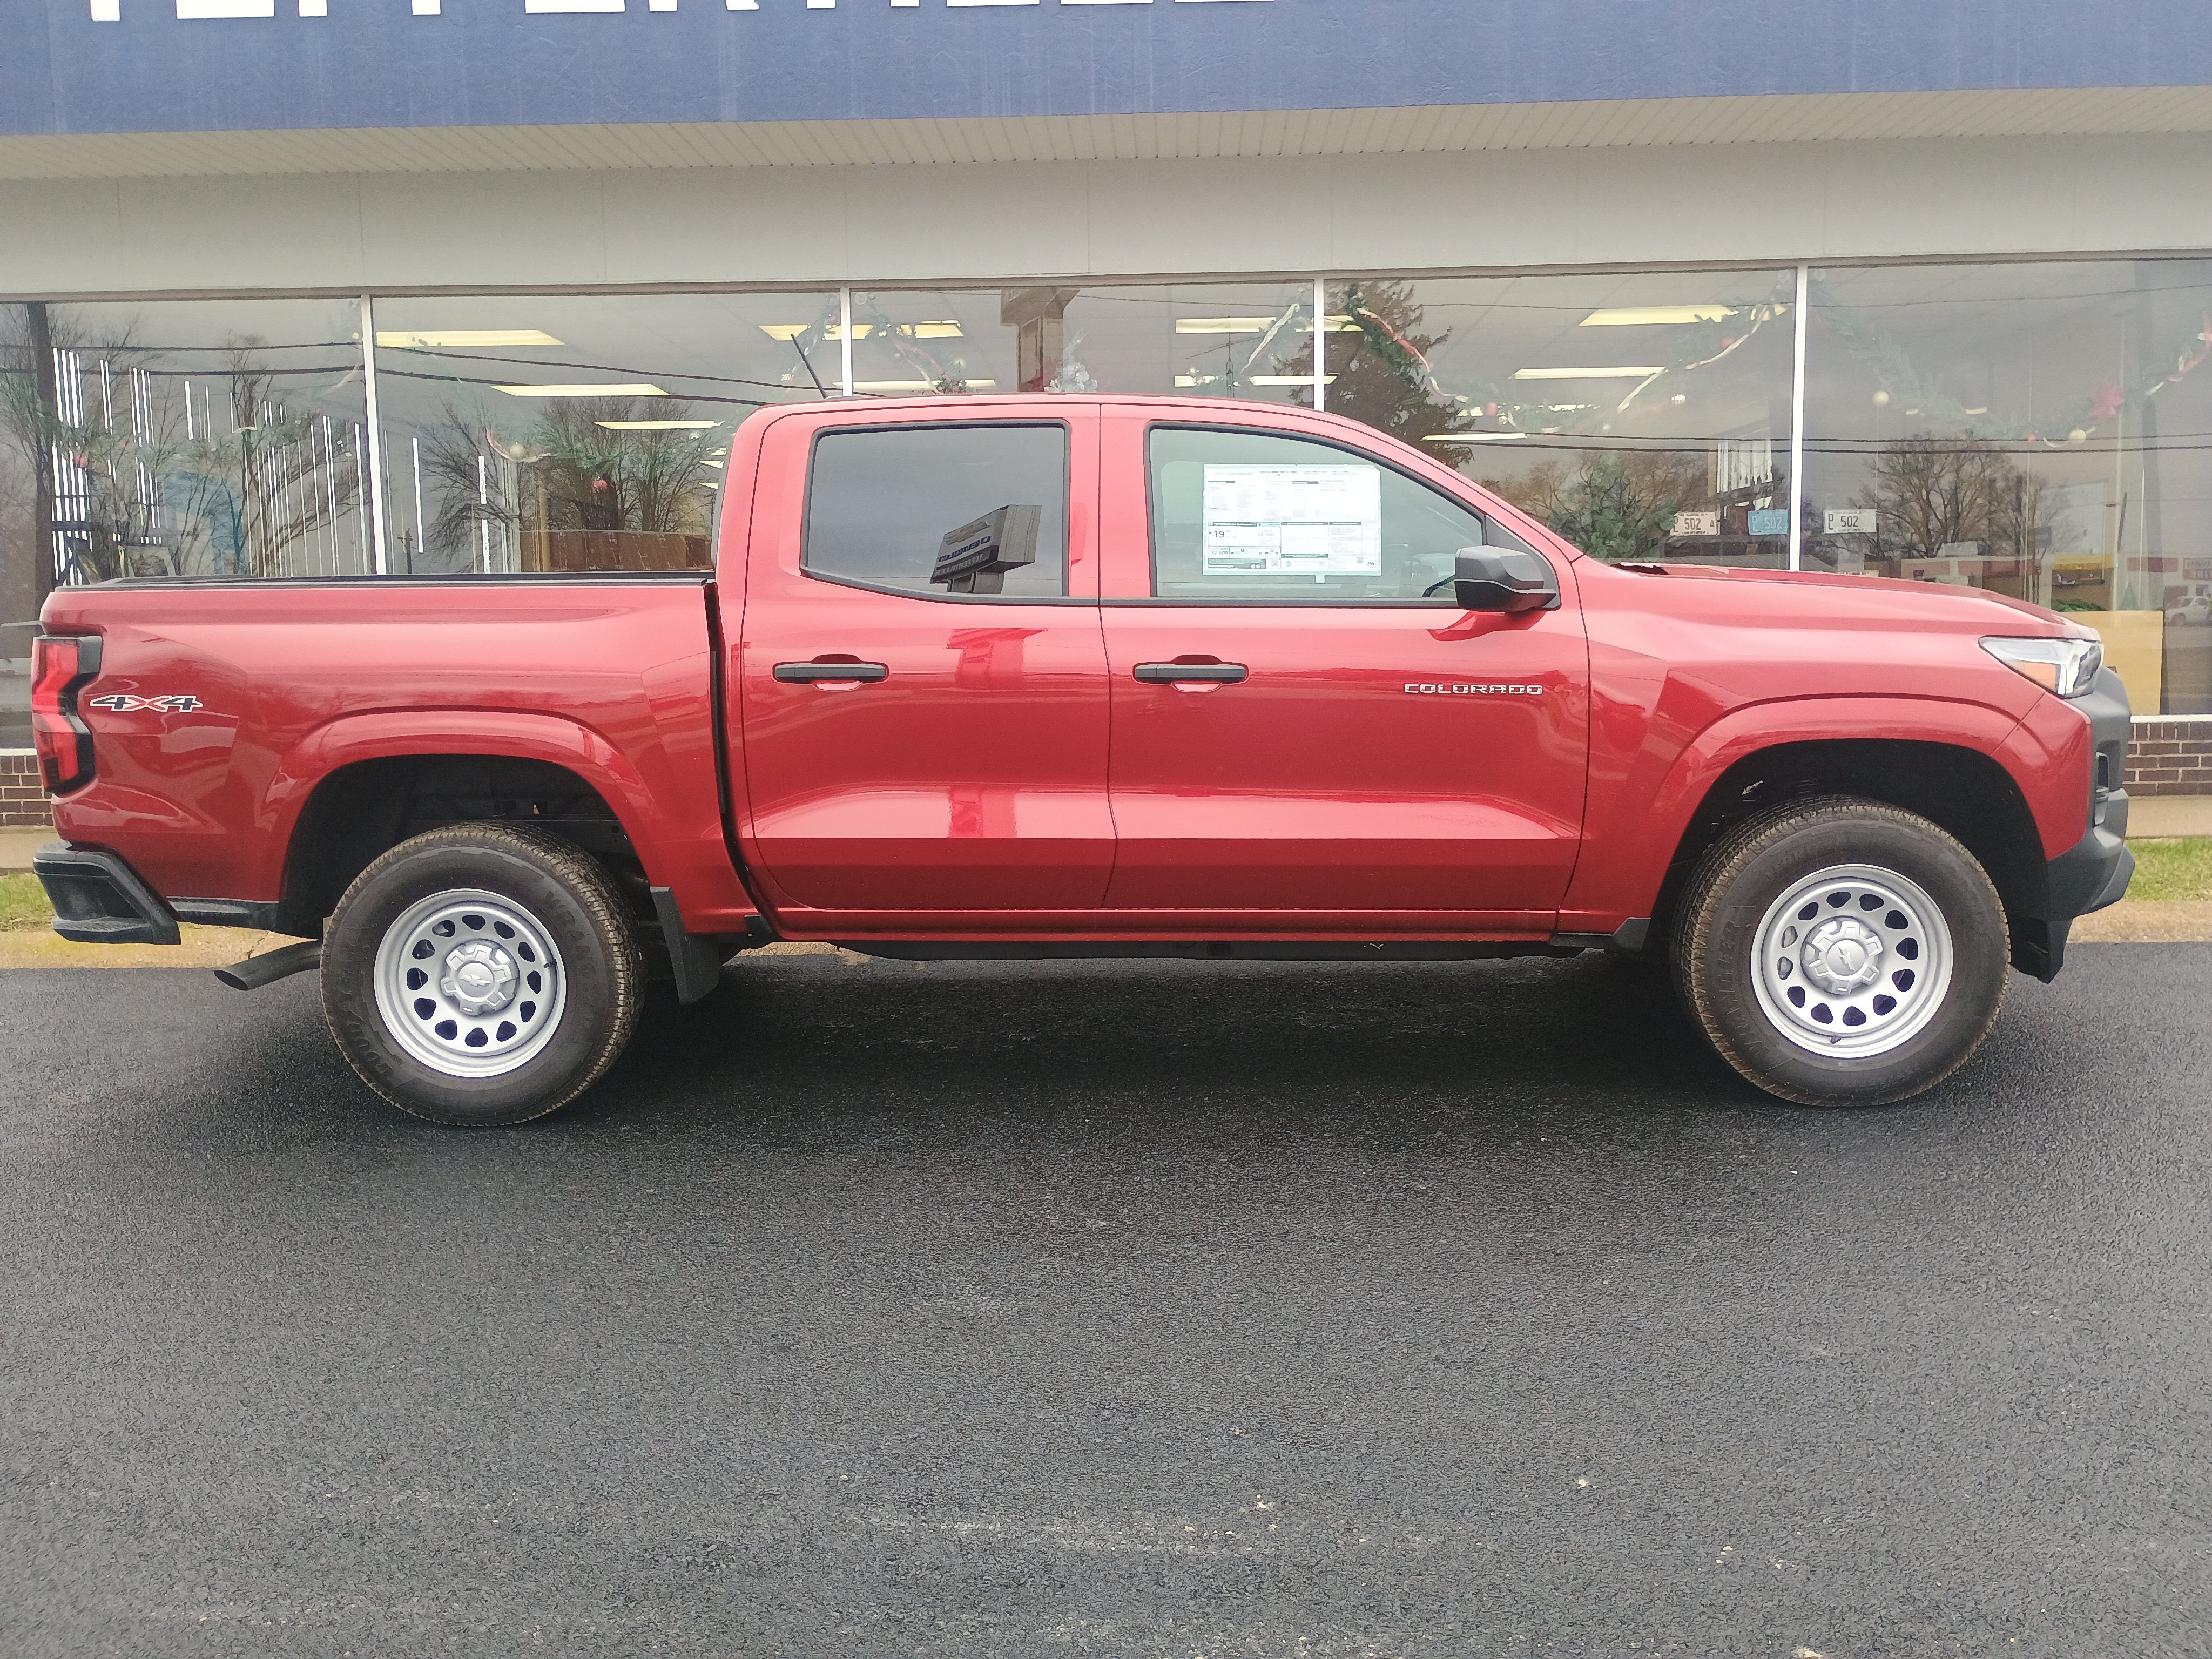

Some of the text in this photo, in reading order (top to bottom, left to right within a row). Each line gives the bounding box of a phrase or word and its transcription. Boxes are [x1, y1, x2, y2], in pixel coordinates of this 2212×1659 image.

[1684, 517, 1701, 530] 502
[1710, 519, 1715, 527] A
[1764, 516, 1783, 529] 502
[1840, 515, 1859, 527] 502
[1404, 683, 1543, 695] COLORADO
